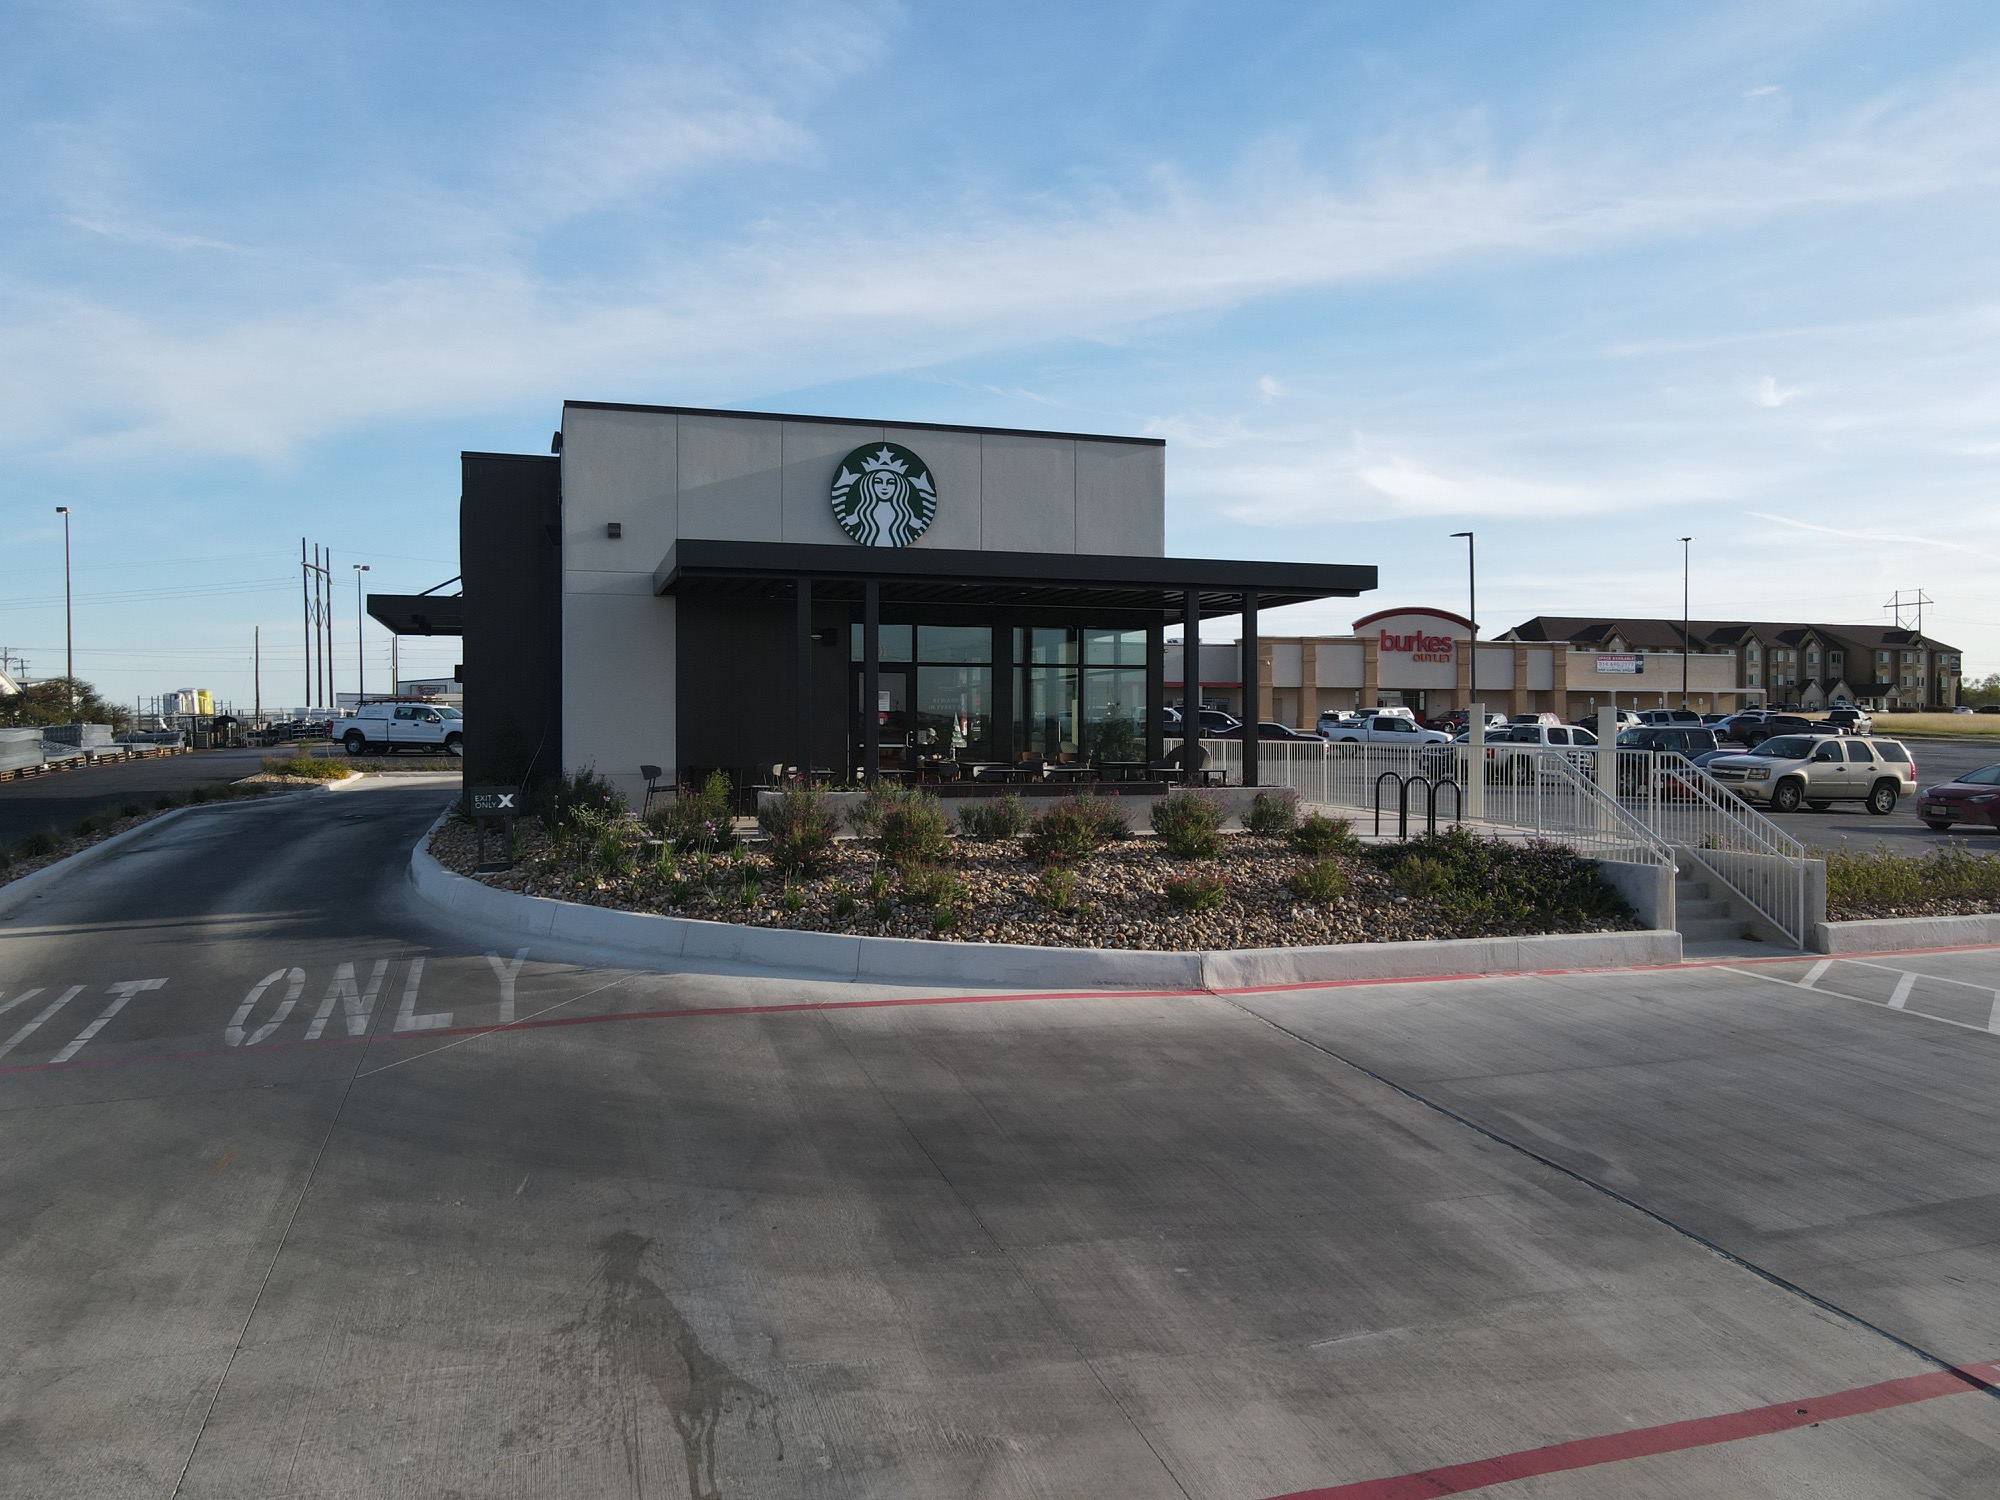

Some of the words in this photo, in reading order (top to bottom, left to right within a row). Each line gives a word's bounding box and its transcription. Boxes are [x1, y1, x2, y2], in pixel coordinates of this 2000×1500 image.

[1380, 629, 1453, 652] burkes
[1412, 653, 1452, 663] OUTLET
[474, 794, 493, 802] EXIT
[0, 978, 169, 1063] IT
[225, 947, 530, 1047] ONLY
